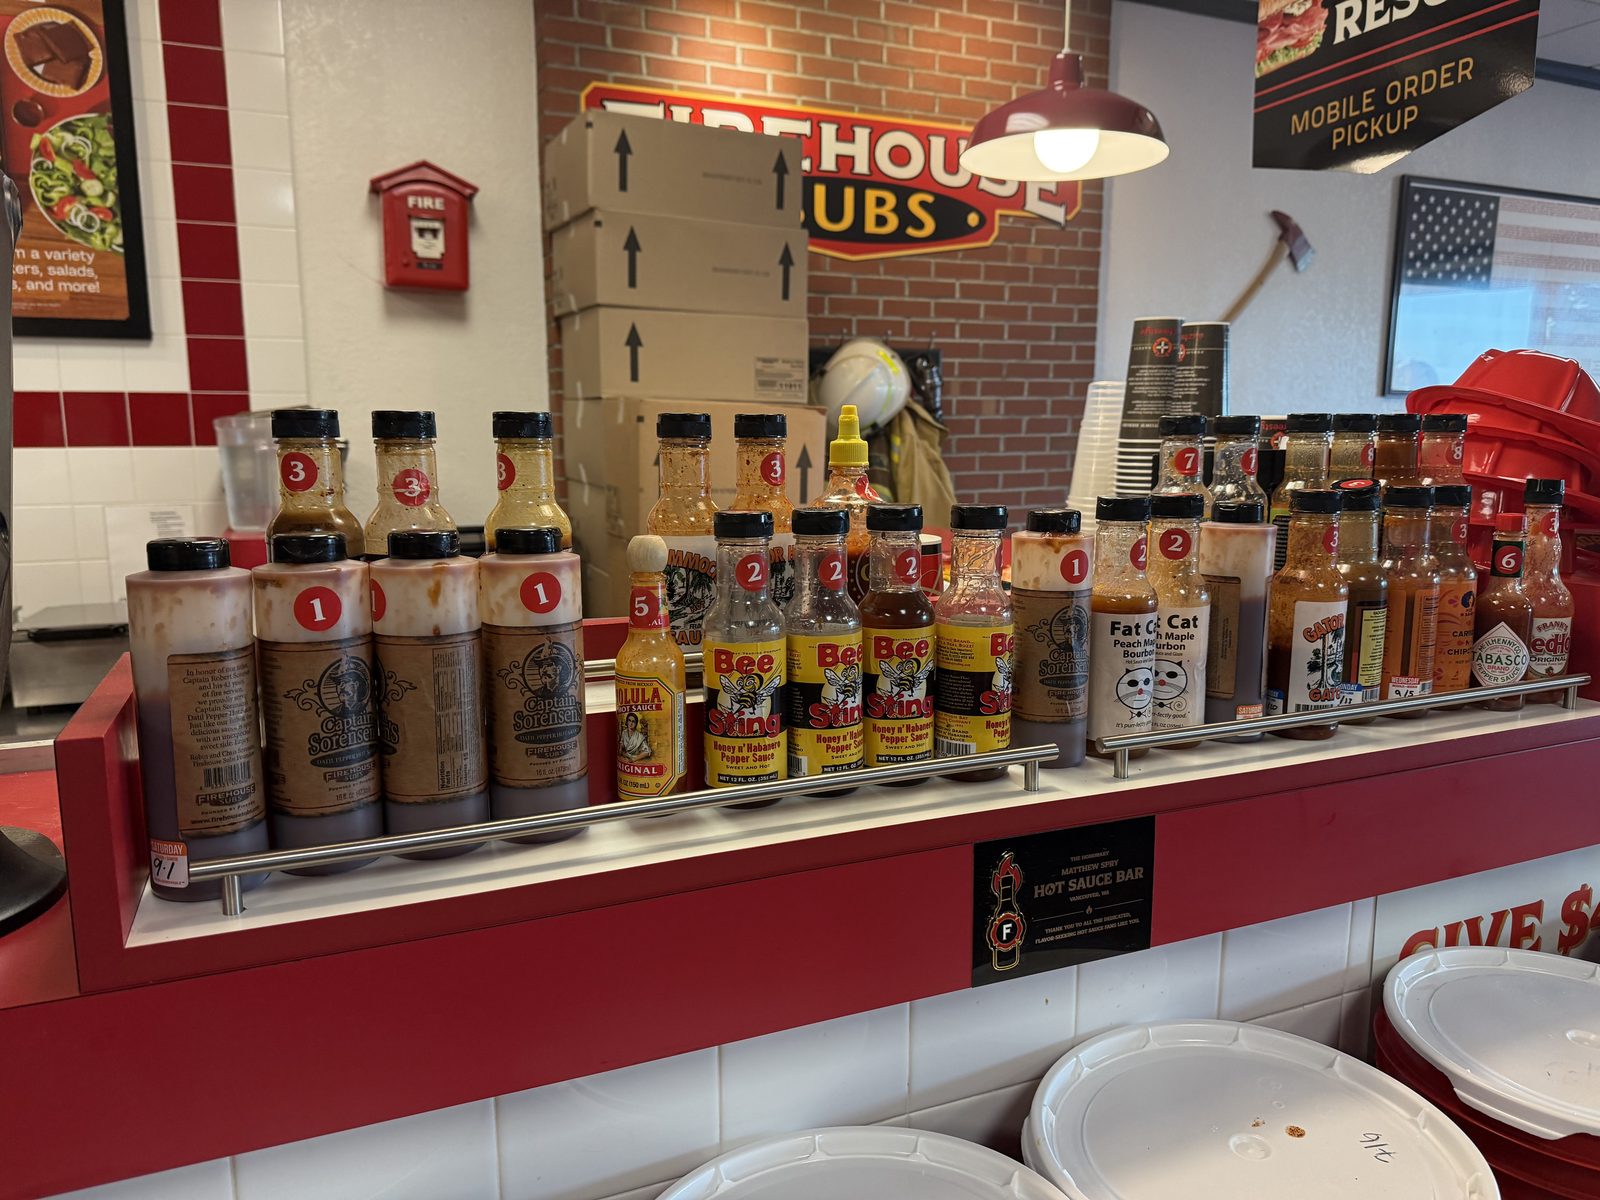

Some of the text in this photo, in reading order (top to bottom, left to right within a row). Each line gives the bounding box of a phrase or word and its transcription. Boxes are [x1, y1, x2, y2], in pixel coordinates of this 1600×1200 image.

[1333, 0, 1457, 45] RES
[1291, 56, 1475, 136] MOBILE ORDER
[1332, 105, 1419, 150] PICKUP
[407, 195, 445, 211] FIRE
[800, 181, 937, 238] UBS
[30, 249, 95, 265] a variety
[47, 265, 98, 280] salads,
[26, 279, 100, 293] and more!
[1184, 453, 1196, 469] 7
[1366, 447, 1374, 460] 8
[1453, 446, 1462, 460] 8
[288, 461, 305, 482] 3
[771, 459, 783, 478] 3
[403, 477, 421, 497] 3
[1330, 530, 1338, 546] 3
[1459, 523, 1468, 538] 3
[1167, 534, 1183, 551] 2
[905, 556, 917, 576] 2
[1071, 558, 1080, 577] 1
[1501, 552, 1517, 568] 6
[746, 562, 762, 582] 2
[830, 561, 842, 580] 2
[533, 582, 549, 605] 1
[309, 598, 326, 622] 1
[634, 596, 649, 616] 5
[1110, 621, 1141, 636] Fat
[1167, 614, 1198, 629] Cat
[1303, 613, 1344, 643] GATOR
[1113, 640, 1141, 648] Peach
[1165, 632, 1194, 642] Maple
[873, 635, 929, 660] Bee
[713, 648, 775, 674] Bee
[1050, 649, 1087, 663] Captain
[1472, 650, 1526, 666] TABASCO
[182, 676, 209, 686] Captain
[211, 673, 232, 682] Robert
[1477, 662, 1520, 682] PEPPER SAUCE
[1391, 676, 1419, 685] WEDNESDAY
[202, 690, 210, 698] of
[195, 704, 221, 713] Captain
[524, 692, 577, 713] Captain
[866, 692, 934, 718] Sting
[1238, 705, 1262, 714] SATURDAY
[187, 712, 204, 721] Datil
[206, 710, 228, 720] Pepper
[708, 707, 781, 738] Sting
[189, 720, 201, 729] Just
[203, 719, 215, 727] like
[190, 726, 220, 735] delicious
[872, 723, 896, 735] Honey
[196, 734, 211, 743] with
[200, 741, 219, 750] sweet
[816, 733, 841, 744] Honey
[880, 732, 929, 745] Pepper Sauce
[528, 741, 576, 757] FIREHOUSE
[713, 741, 736, 754] Honey
[746, 740, 781, 753] Habanero
[825, 743, 852, 753] Pepper
[721, 752, 775, 765] Pepper Sauce
[326, 761, 375, 782] FIREHOUSE
[198, 784, 254, 806] FIREHOUSE
[219, 796, 242, 805] SUBS
[1061, 859, 1119, 876] MATTHEW SPRY
[1034, 867, 1144, 898] HOT SAUCE BAR
[1002, 923, 1012, 940] F
[1045, 925, 1063, 934] THANK
